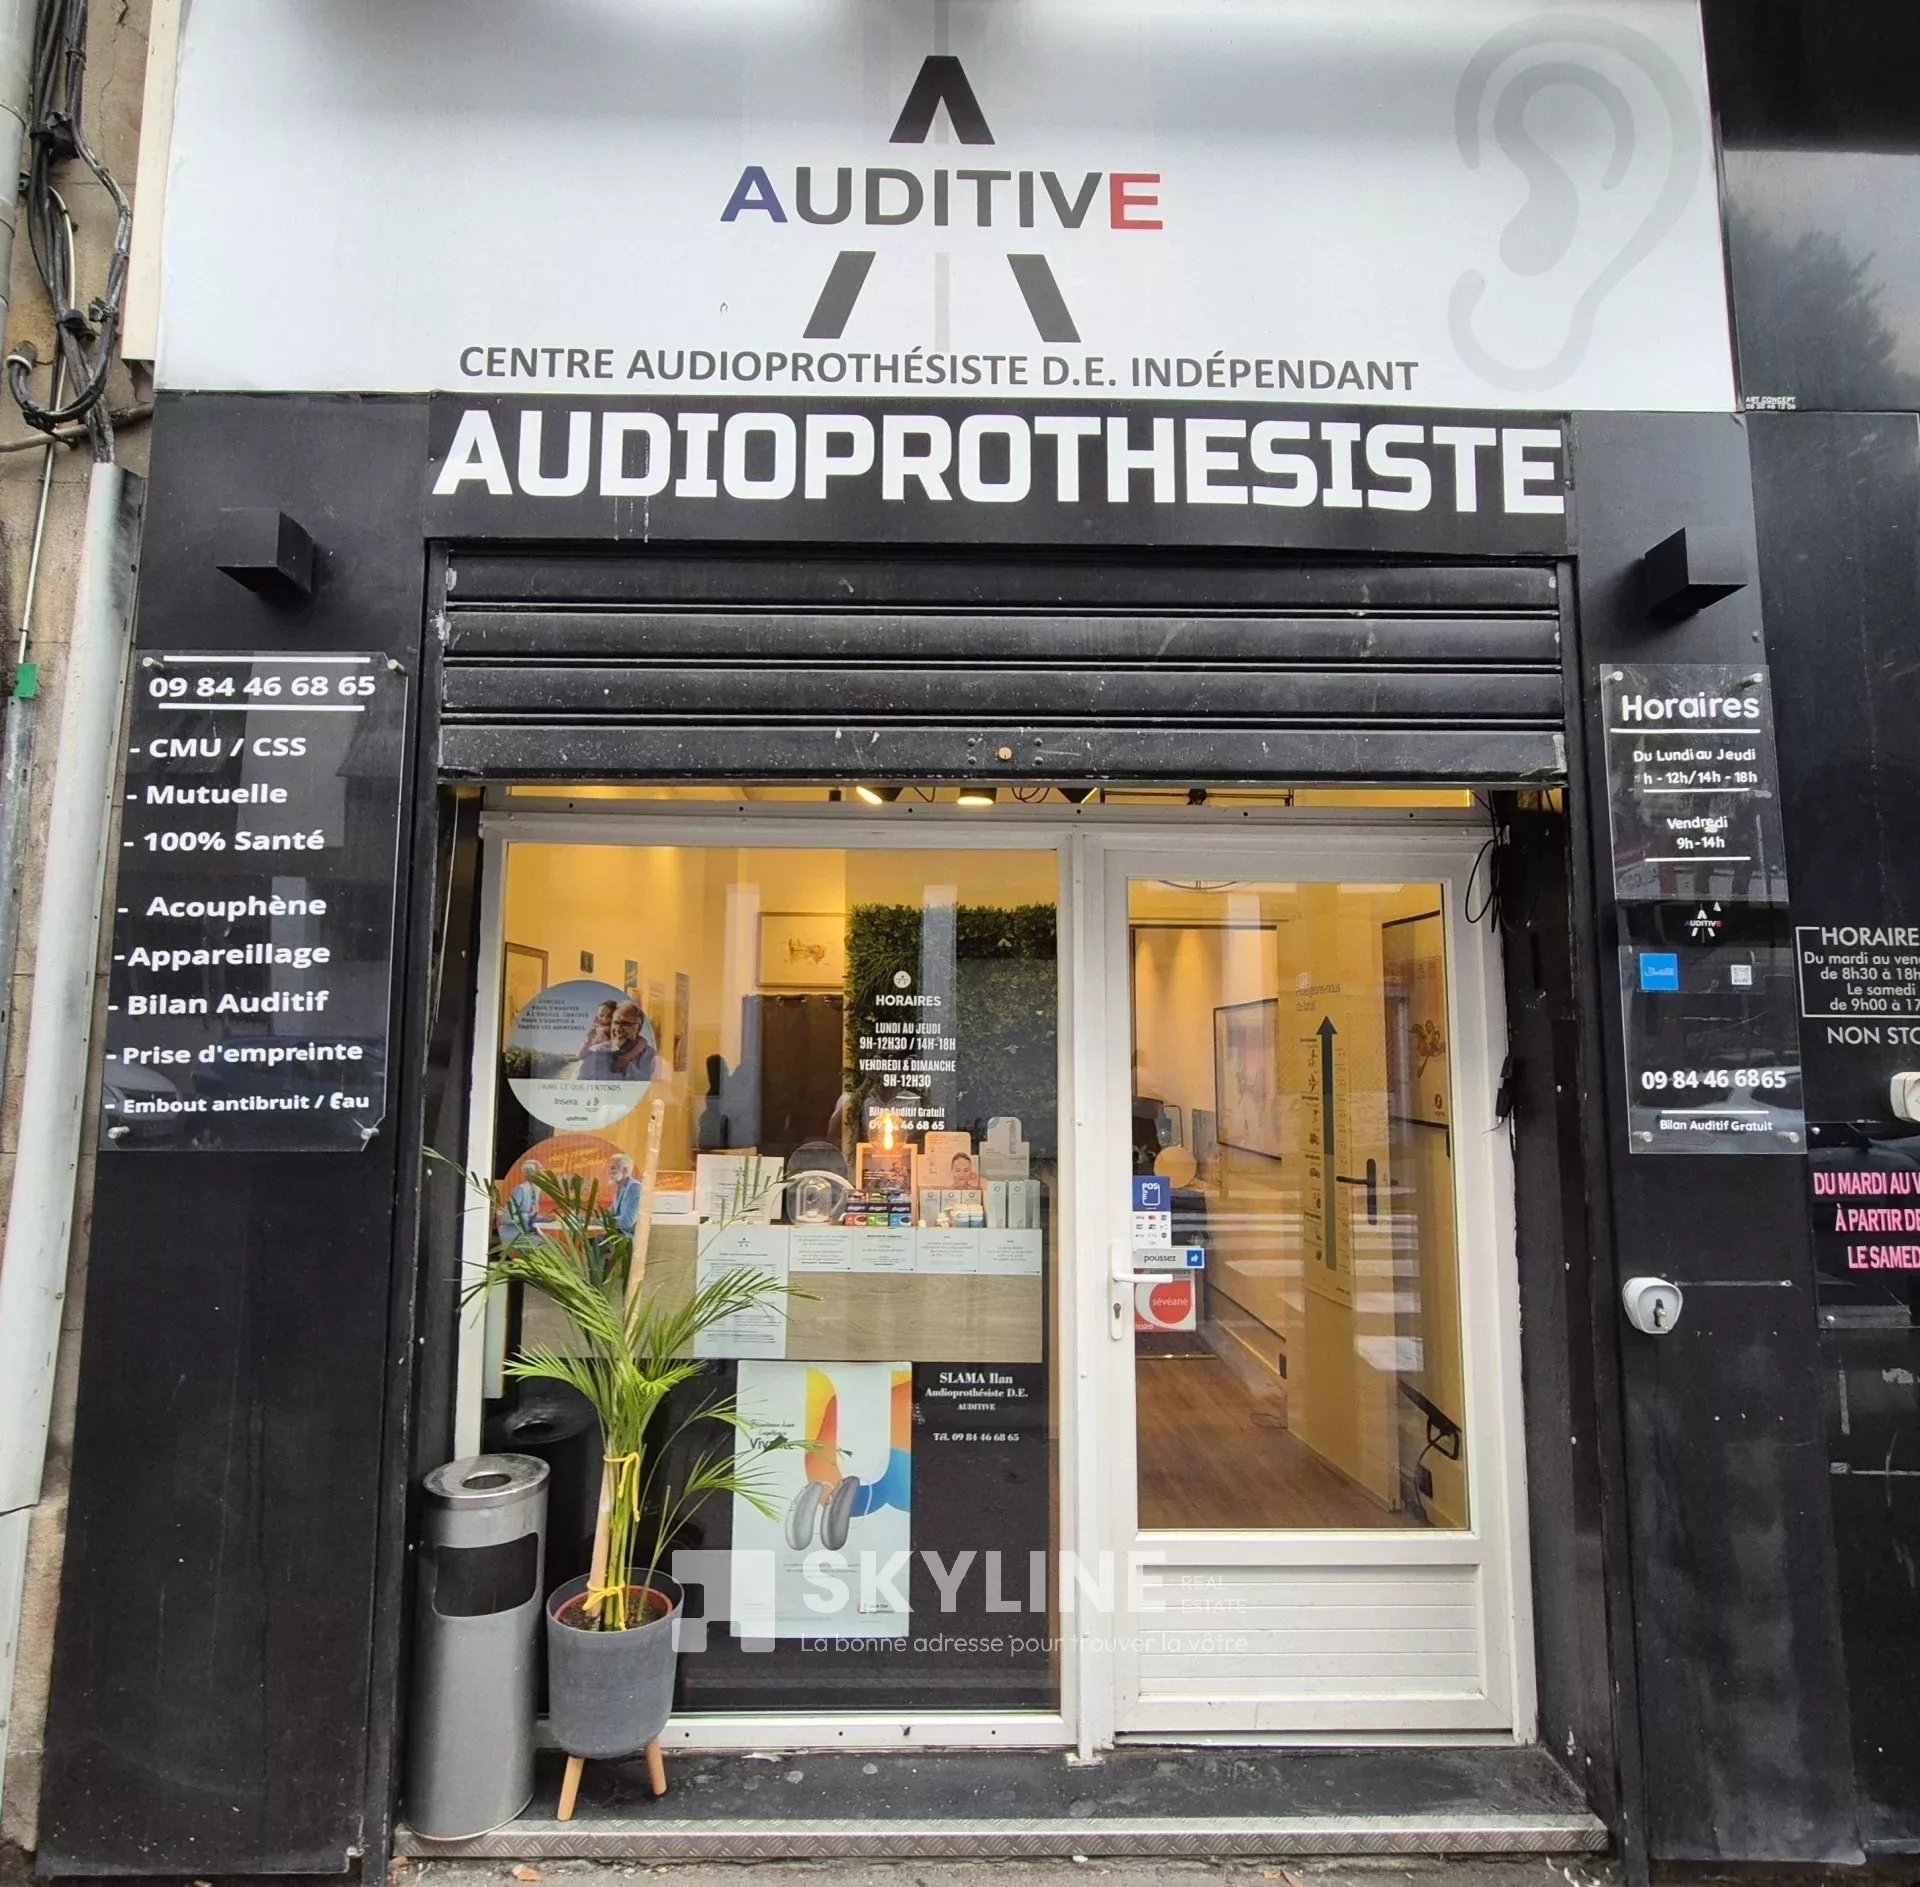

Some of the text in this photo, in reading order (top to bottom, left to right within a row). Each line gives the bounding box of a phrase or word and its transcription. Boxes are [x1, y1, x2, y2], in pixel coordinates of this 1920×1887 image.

[720, 165, 1163, 230] AUDITIVE
[459, 345, 1419, 391] CENTRE AUDIOPROTHÉSISTE D.E. INDÉPENDANT
[432, 408, 1565, 514] AUDIOPROTHESISTE
[149, 675, 376, 698] 09 84 46 68 65
[1622, 693, 1760, 721] Horaires
[149, 737, 221, 758] CMU
[253, 737, 307, 757] CSS
[1633, 749, 1756, 762] Du Lundi au Jeudi
[1734, 771, 1758, 784] 18h
[146, 783, 288, 804] Mutuelle
[1667, 816, 1728, 830] Vendredi
[144, 831, 226, 852] 100%
[235, 829, 325, 852] Santé
[146, 895, 326, 922] Acouphène
[1685, 919, 1723, 928] AUDITIVE
[1804, 951, 1824, 964] Du
[1828, 951, 1868, 965] mardi
[1872, 955, 1890, 965] au
[1820, 967, 1838, 980] de
[1842, 967, 1878, 980] 8h30
[1881, 967, 1891, 980] à
[1847, 983, 1916, 996] Le samedi
[128, 994, 207, 1015] Bilan
[216, 991, 330, 1014] Auditif
[875, 995, 941, 1007] HORAIRES
[1829, 997, 1847, 1011] de
[1851, 998, 1887, 1011] 9h00
[1891, 999, 1901, 1011] à
[875, 1022, 941, 1034] LUNDI AU JEUDI
[1827, 1026, 1880, 1044] NON
[859, 1036, 907, 1050] 9H-12H30
[917, 1037, 956, 1050] 14H-18H
[123, 1046, 191, 1065] Prise
[198, 1042, 363, 1067] d'empreinte
[859, 1059, 900, 1071] VENDREDI
[911, 1060, 956, 1072] DIMANCHE
[883, 1073, 931, 1088] 9H-12H30
[1642, 1070, 1667, 1090] 09
[1672, 1070, 1699, 1089] 84
[1703, 1069, 1729, 1088] 46
[123, 1098, 208, 1114] Embout
[212, 1095, 310, 1111] antibruit
[917, 1107, 945, 1117] Gratuit
[916, 1120, 930, 1130] 68
[931, 1121, 945, 1130] 65
[1660, 1119, 1774, 1131] Bilan Auditif Gratuit
[1813, 1172, 1836, 1195] DU
[1837, 1172, 1887, 1195] MARDI
[1889, 1172, 1911, 1194] AU
[1835, 1202, 1847, 1231] À
[1847, 1209, 1904, 1231] PARTIR
[1144, 1254, 1177, 1264] poussez
[1847, 1245, 1869, 1269] LE
[1152, 1297, 1188, 1306] sévéane
[939, 1372, 1014, 1384] SLAMA Ilan
[925, 1387, 1029, 1399] Audioprothésiste D.E.
[957, 1403, 996, 1411] AUDITIVE
[952, 1432, 964, 1442] 09
[965, 1432, 977, 1442] 84
[980, 1432, 991, 1442] 46
[993, 1432, 1006, 1442] 68
[1007, 1432, 1020, 1442] 65
